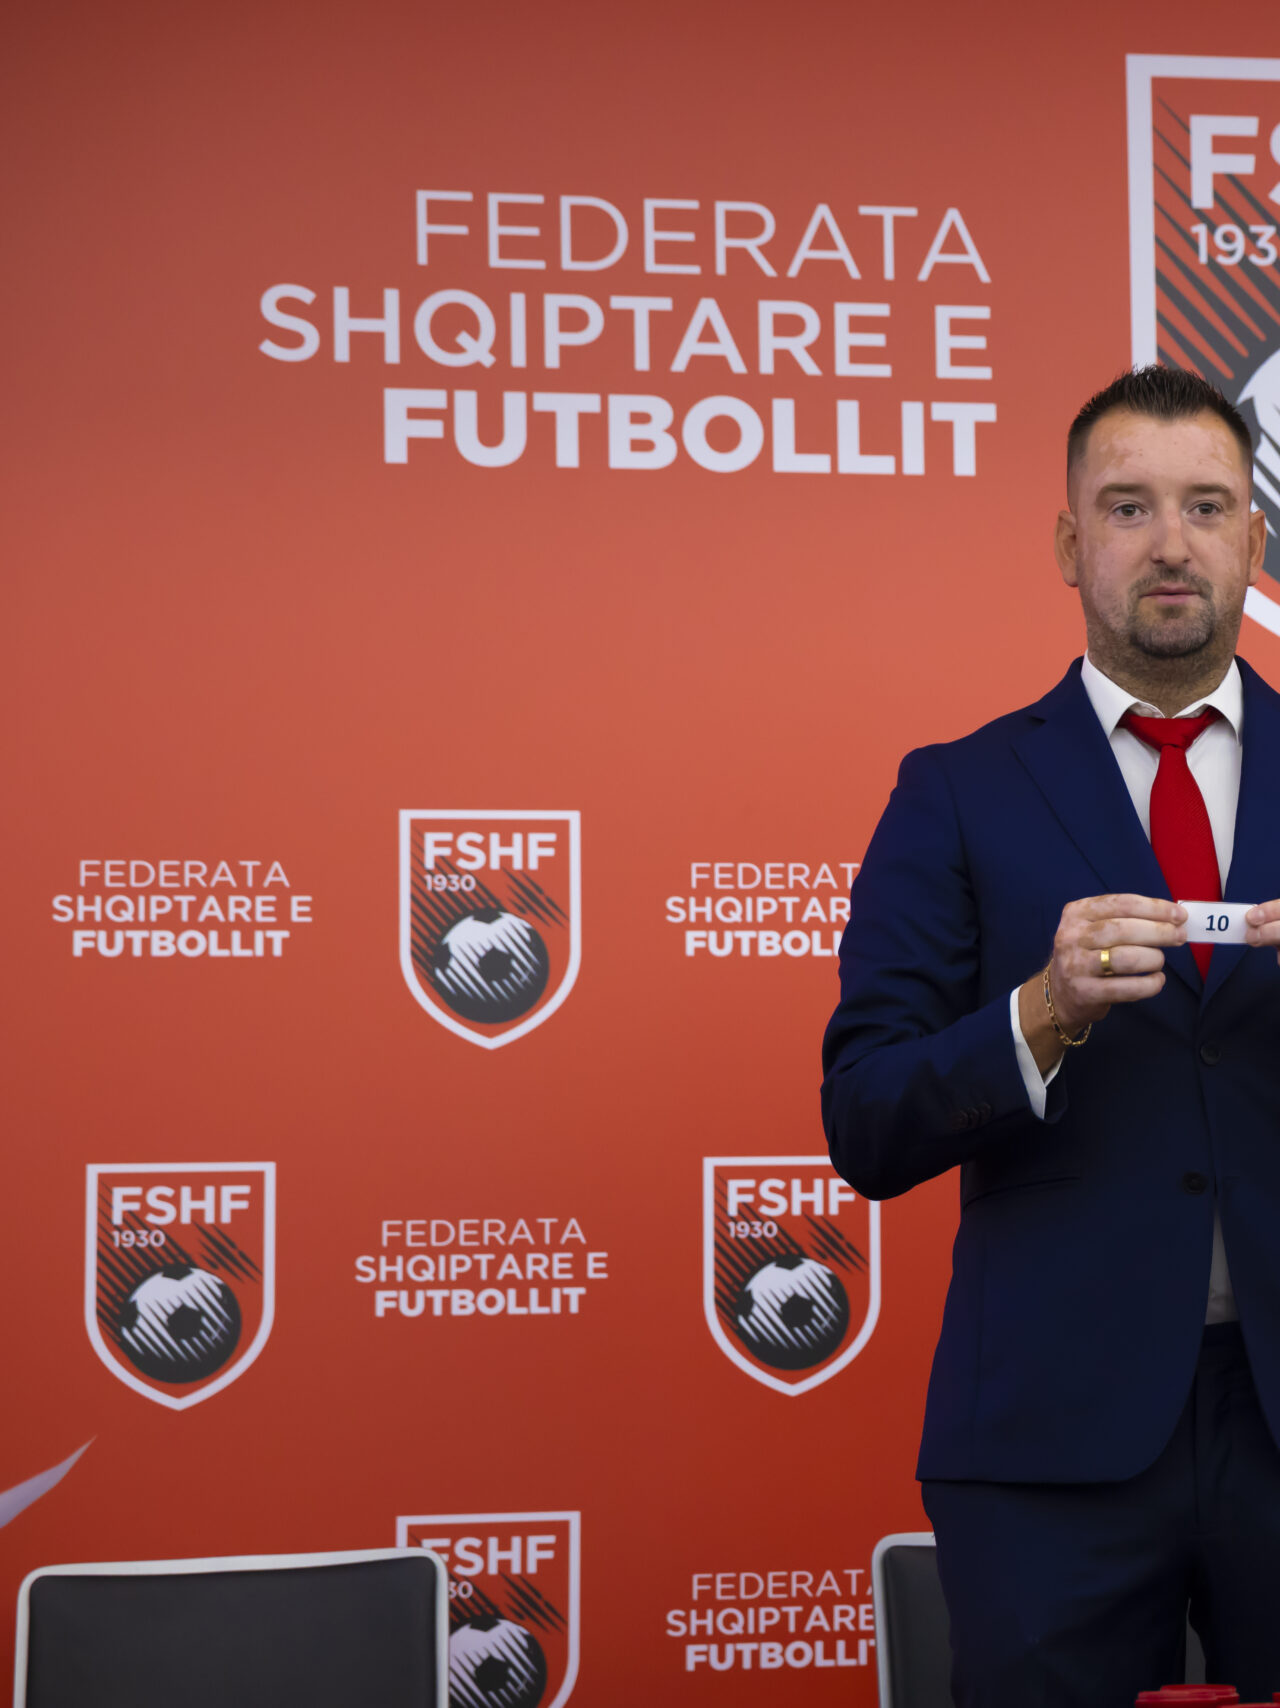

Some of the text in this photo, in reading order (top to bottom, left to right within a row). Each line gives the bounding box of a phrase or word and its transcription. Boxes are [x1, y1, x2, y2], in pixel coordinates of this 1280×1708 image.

[415, 189, 992, 283] FEDERATA
[258, 283, 993, 381] SHQIPTARE E
[383, 387, 998, 477] FUTBOLLIT
[423, 831, 558, 871] FSHF
[79, 859, 291, 889] FEDERATA
[423, 873, 477, 893] 1930
[690, 862, 861, 890] FEDERAT
[52, 894, 313, 923] SHQIPTARE E
[665, 895, 851, 924] SHQIPTAR
[1205, 914, 1230, 932] 10
[72, 929, 291, 958] FUTBOLLIT
[684, 929, 843, 958] FUTBOL
[111, 1184, 251, 1226] FSHF
[727, 1177, 856, 1217] FSHF
[111, 1229, 166, 1248] 1930
[381, 1217, 587, 1248] FEDERATA
[727, 1220, 779, 1239] 1930
[354, 1251, 609, 1284] SHQIPTARE E
[374, 1286, 587, 1318] FUTBOLLIT
[691, 1568, 872, 1601] FEDERAT
